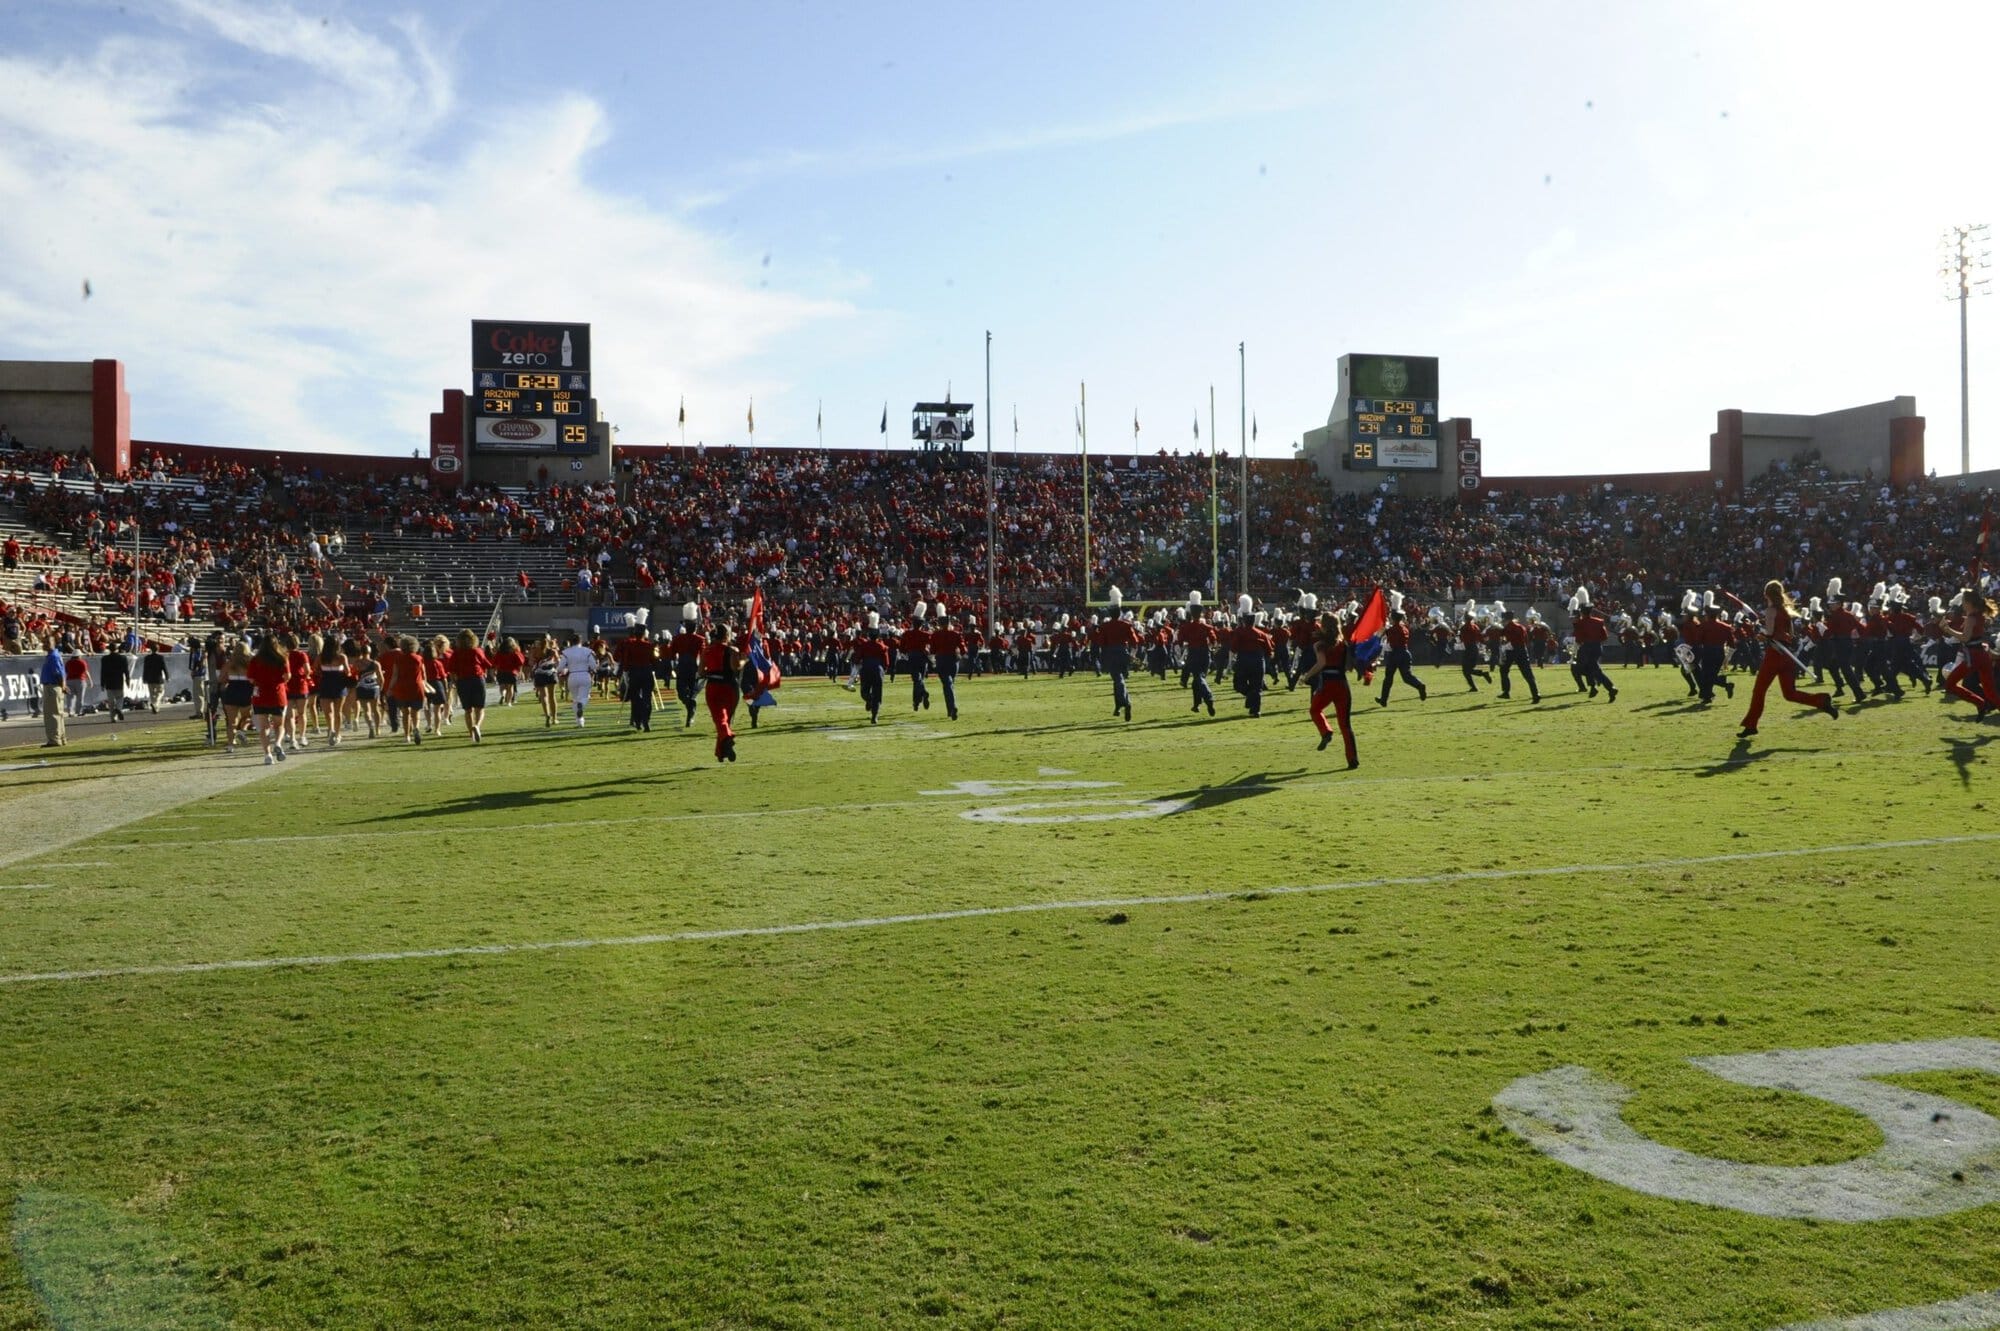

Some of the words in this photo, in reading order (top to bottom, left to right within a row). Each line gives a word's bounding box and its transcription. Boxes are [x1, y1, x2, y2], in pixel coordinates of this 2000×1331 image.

[491, 327, 557, 353] Coke
[502, 352, 547, 365] zero
[518, 374, 559, 389] 6:29
[484, 389, 520, 399] ARIZONA
[553, 391, 571, 400] WSU
[495, 401, 511, 412] 34
[535, 402, 543, 412] 3
[553, 401, 569, 413] 00
[1384, 401, 1415, 413] 6:29
[1359, 414, 1386, 422] ARIZONA
[499, 423, 534, 433] CHAPMAN
[1367, 423, 1379, 432] 34
[1397, 424, 1404, 433] 3
[1410, 424, 1423, 434] 00
[565, 426, 585, 442] 25
[1354, 443, 1373, 459] 25
[571, 461, 583, 470] 10
[6, 673, 43, 700] FAR
